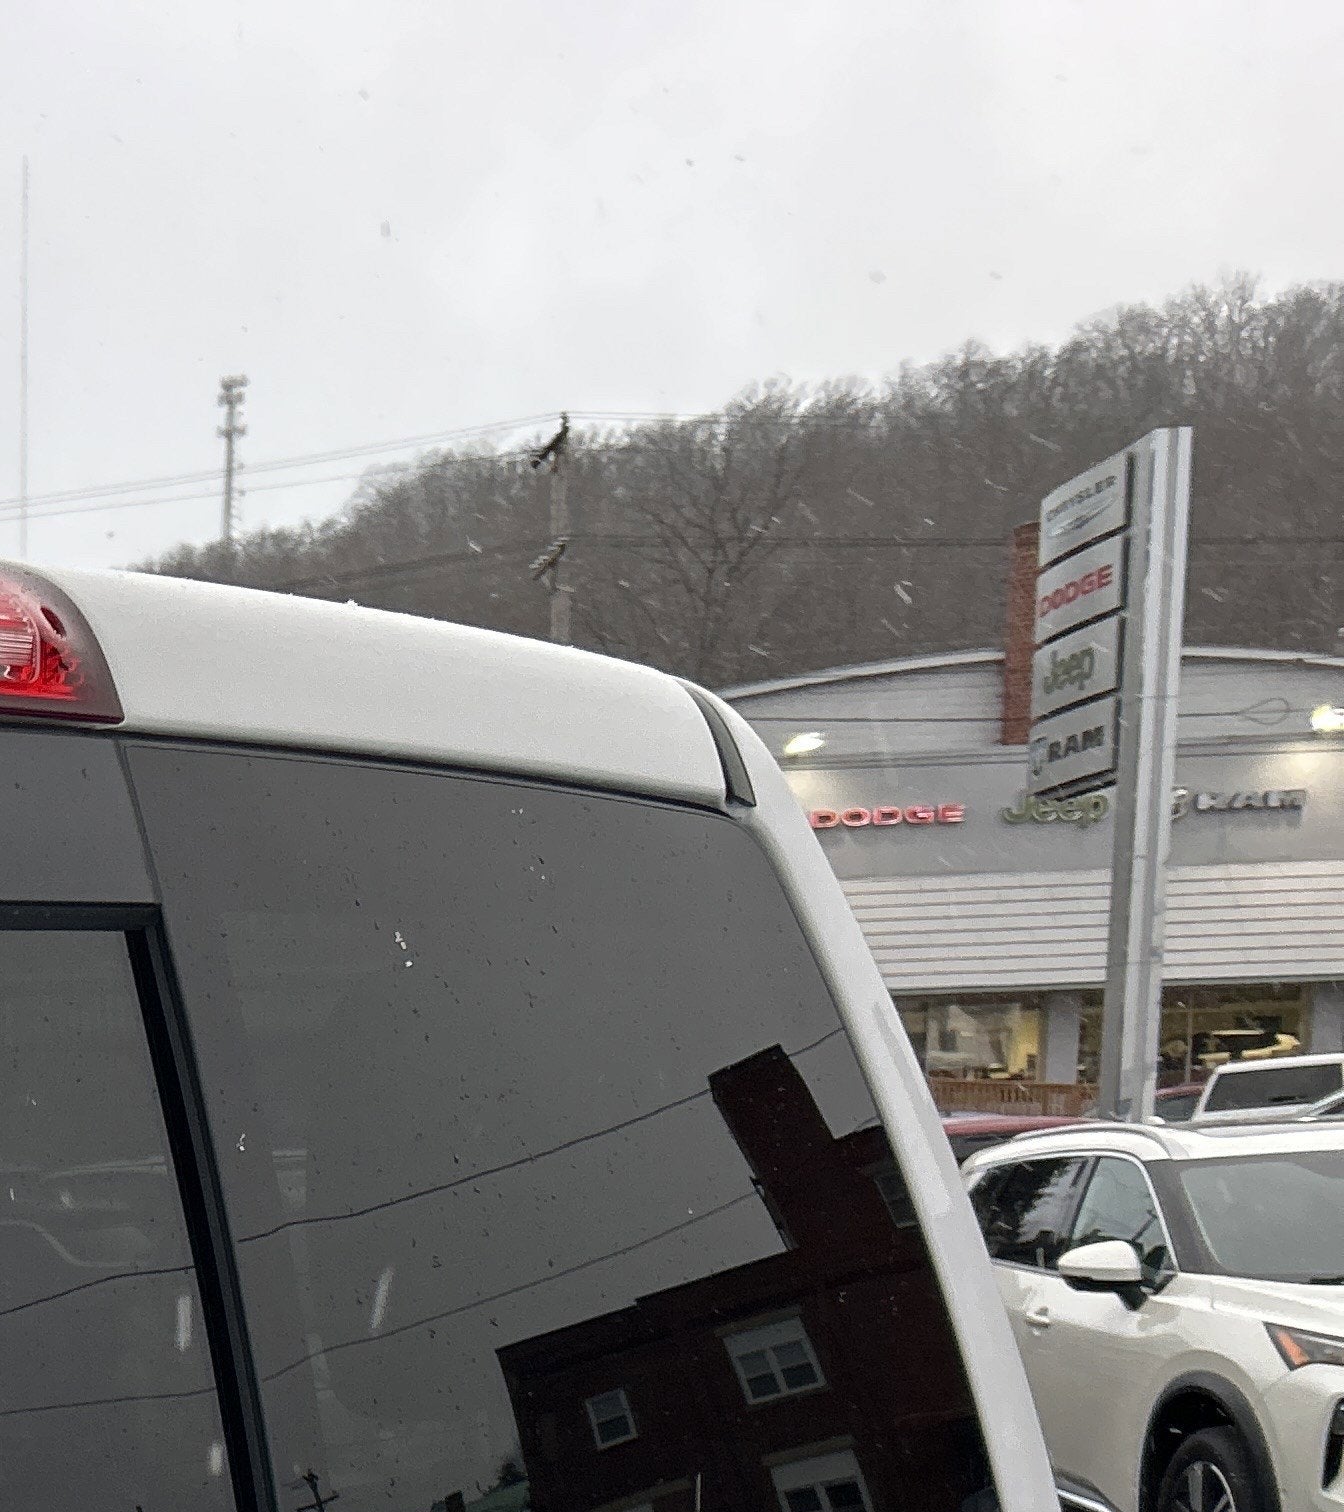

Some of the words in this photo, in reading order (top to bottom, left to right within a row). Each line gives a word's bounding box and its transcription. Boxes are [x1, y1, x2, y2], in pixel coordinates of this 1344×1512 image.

[1038, 563, 1113, 617] DODGE
[1043, 645, 1095, 694] Jeep
[1048, 725, 1105, 763] RAM
[810, 803, 965, 829] DODGE
[1001, 793, 1109, 828] Jeep
